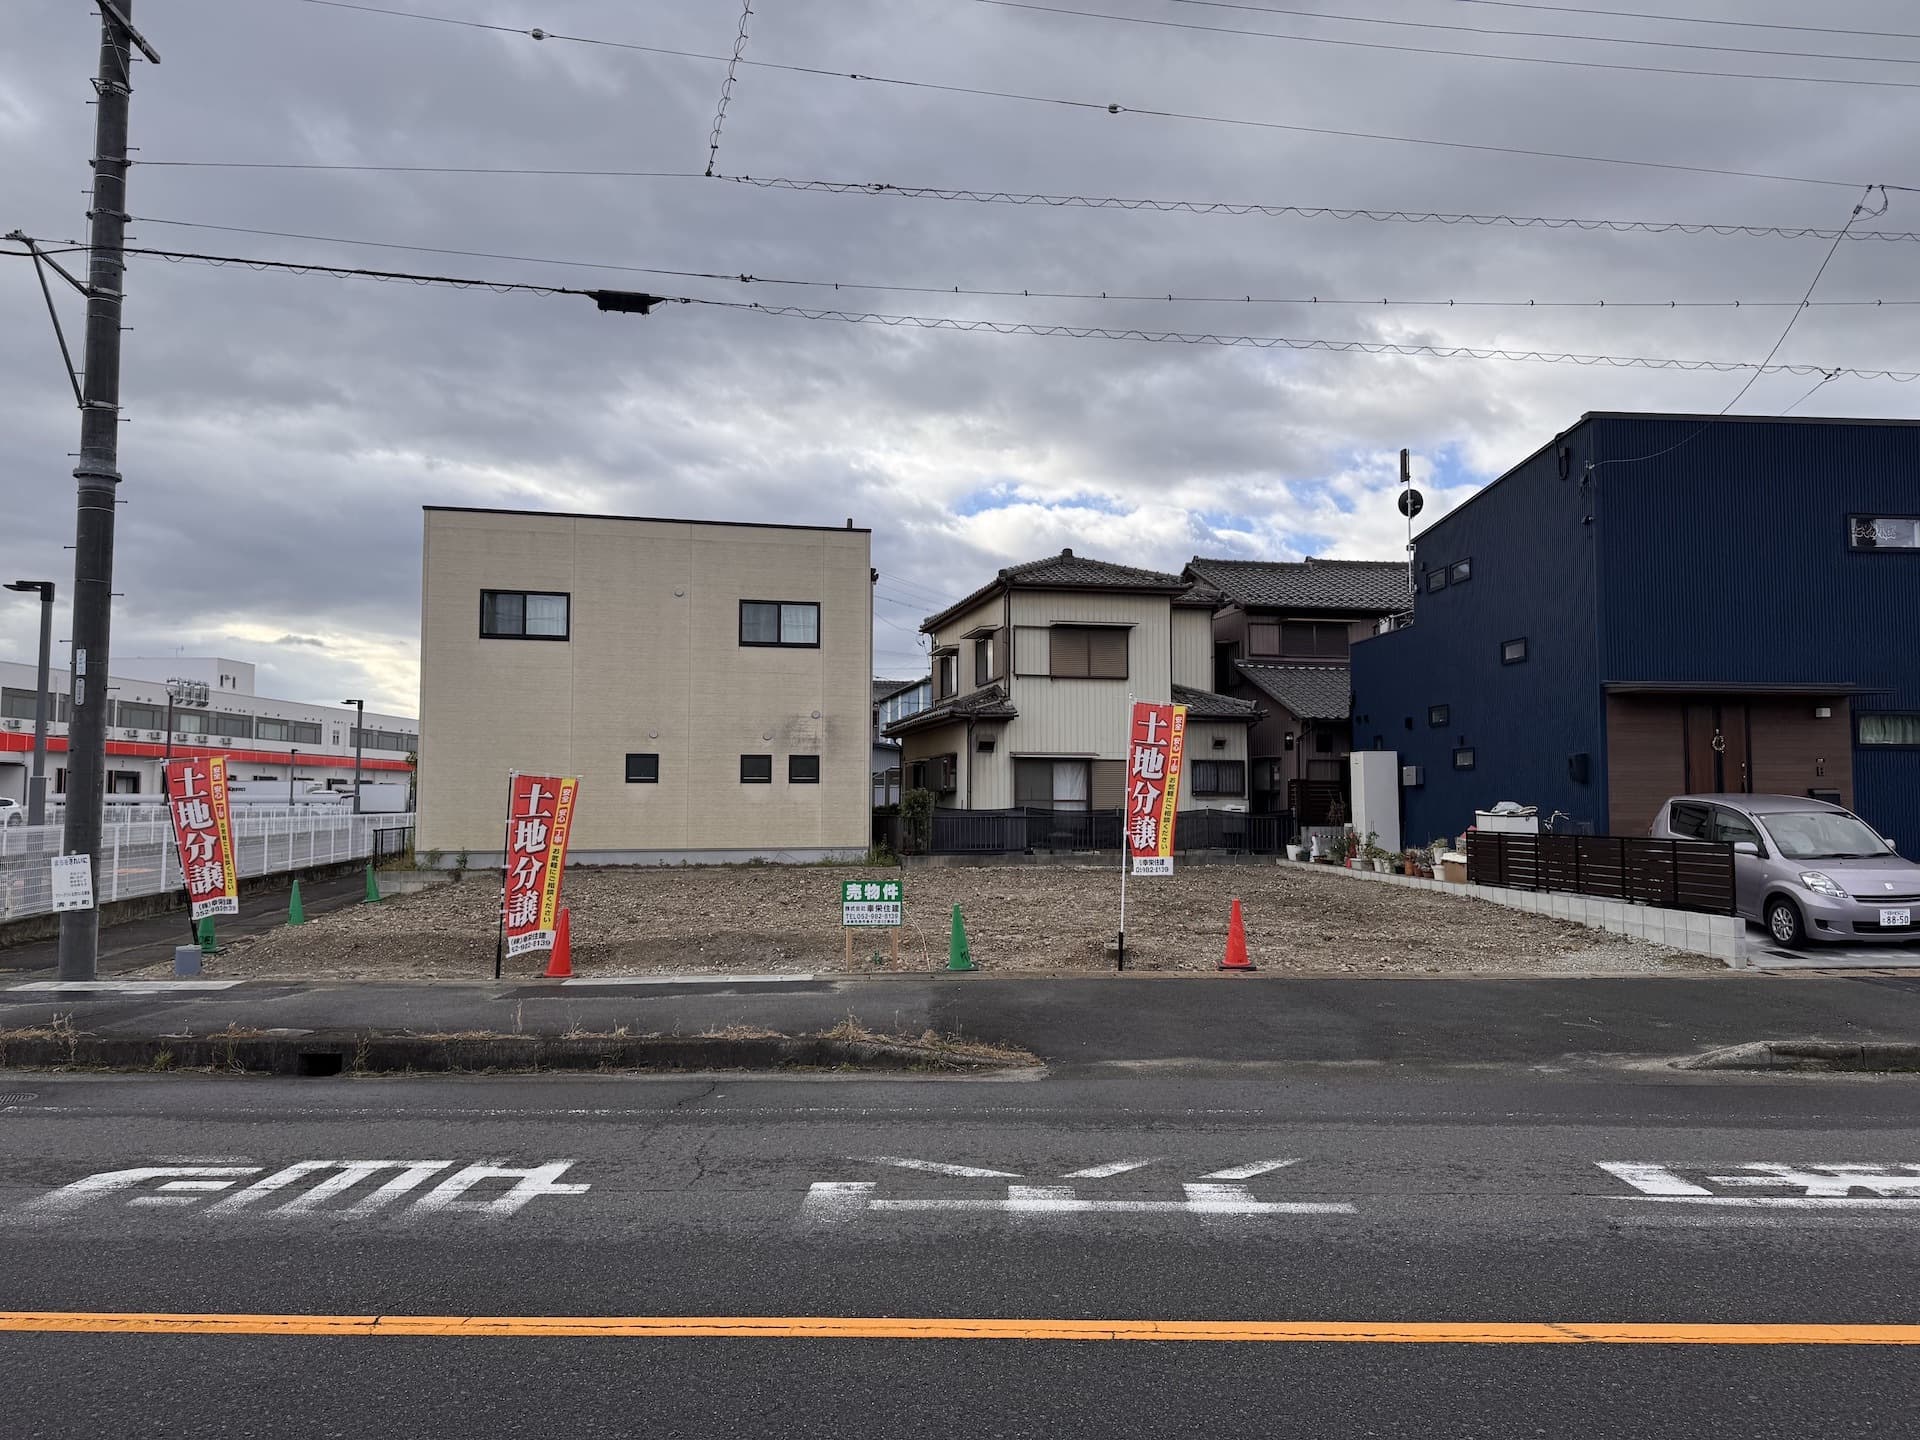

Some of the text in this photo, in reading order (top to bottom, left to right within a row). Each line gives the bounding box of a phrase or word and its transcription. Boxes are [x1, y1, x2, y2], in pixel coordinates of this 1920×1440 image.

[173, 767, 225, 895] 土地分譲
[1131, 711, 1169, 849] 土地分譲
[508, 783, 553, 928] 土地分譲
[846, 883, 899, 900] 売物件
